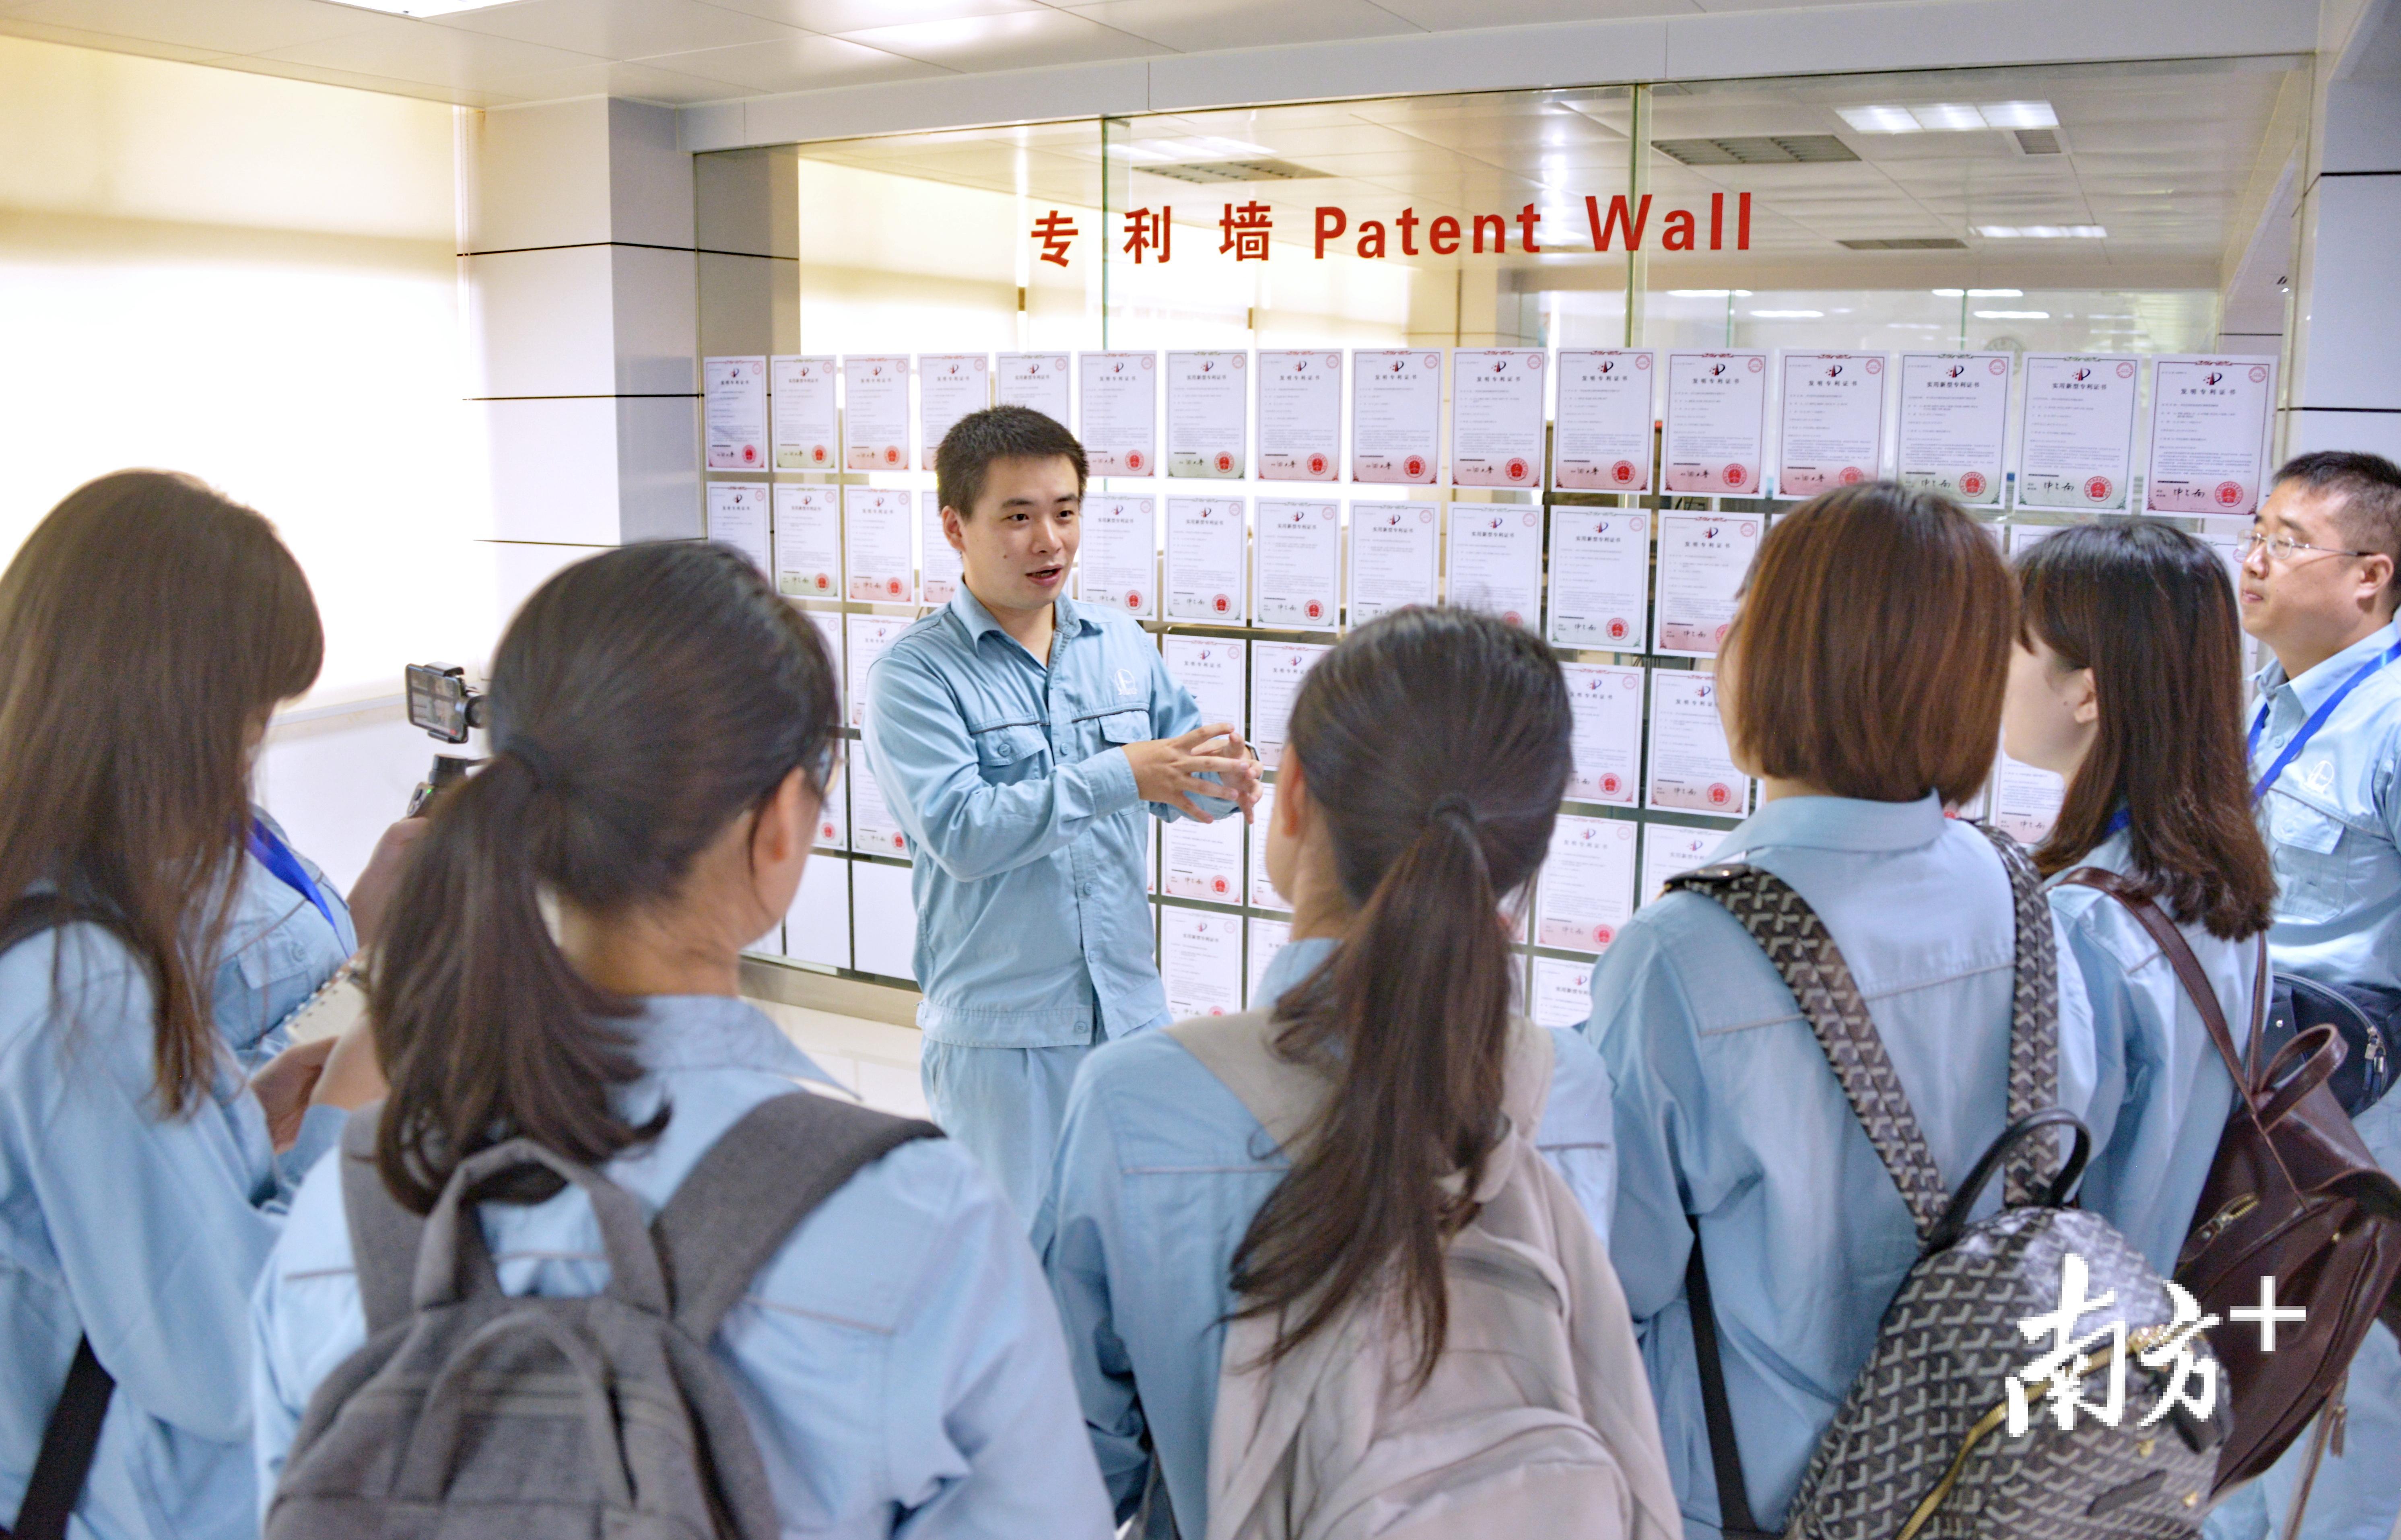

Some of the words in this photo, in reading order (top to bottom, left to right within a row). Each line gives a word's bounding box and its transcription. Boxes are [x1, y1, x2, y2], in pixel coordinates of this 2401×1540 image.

[1031, 201, 1273, 267] 专利墙
[1315, 203, 1541, 259] Patent
[1585, 192, 1751, 252] Wall
